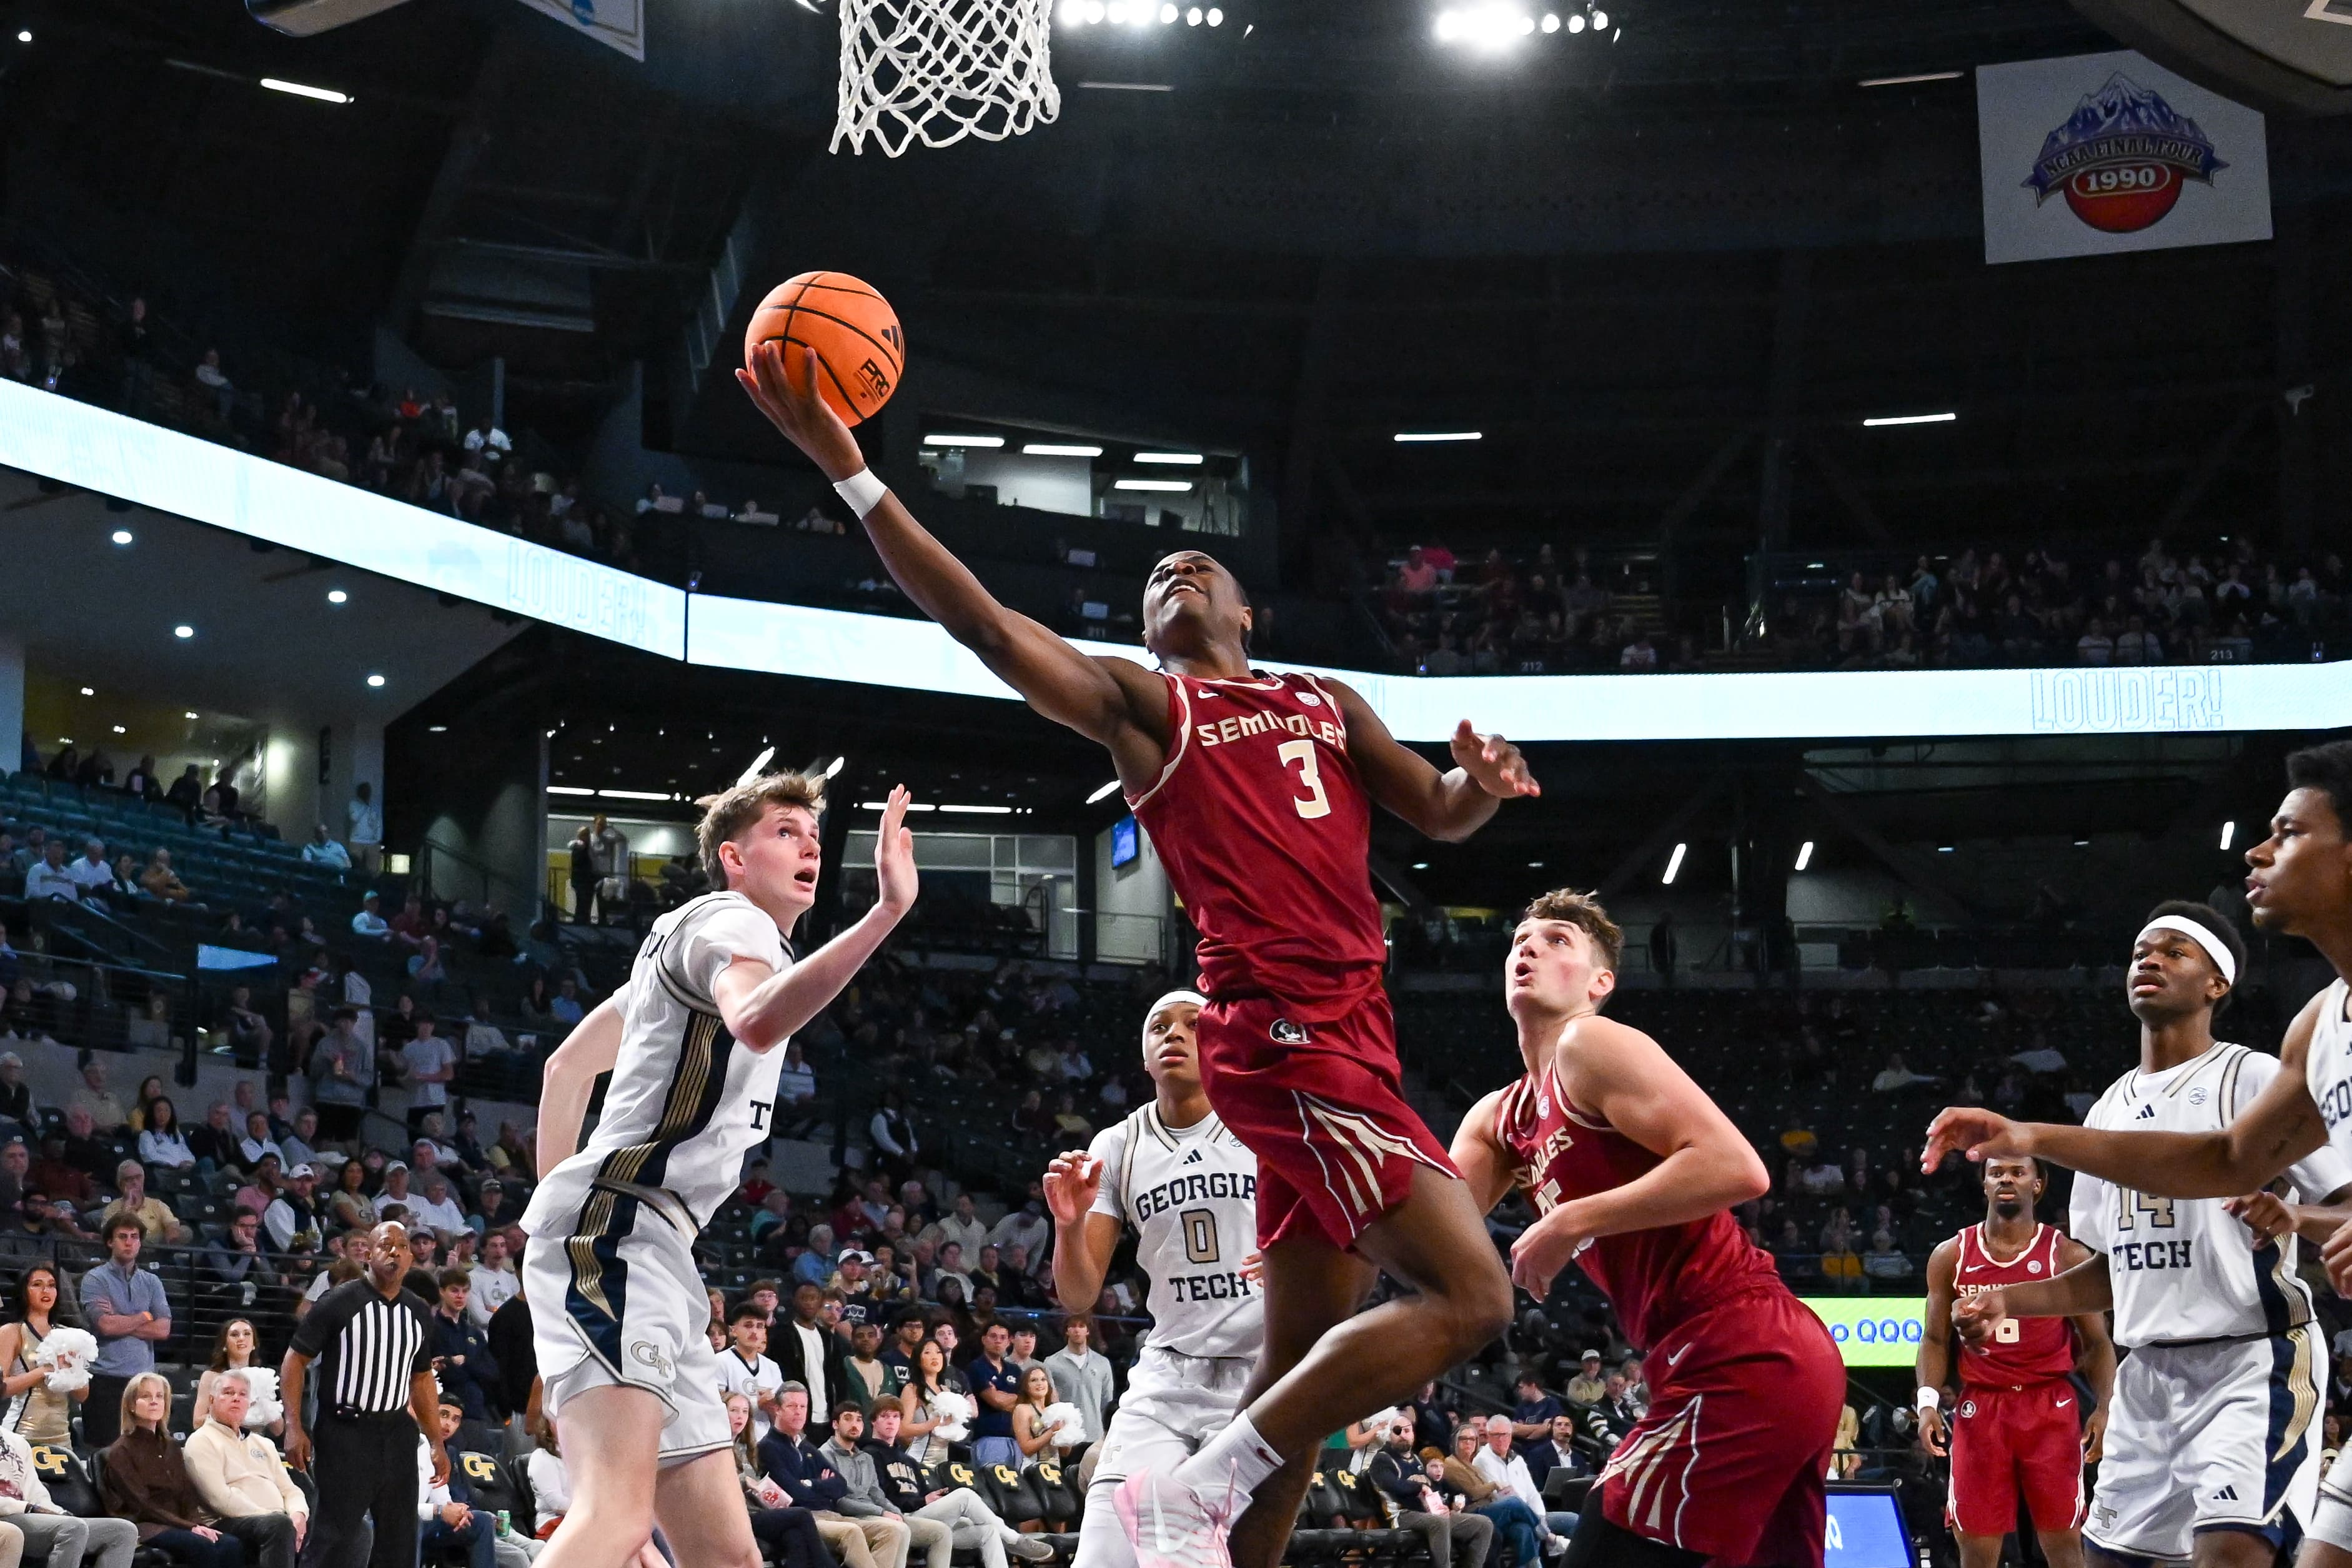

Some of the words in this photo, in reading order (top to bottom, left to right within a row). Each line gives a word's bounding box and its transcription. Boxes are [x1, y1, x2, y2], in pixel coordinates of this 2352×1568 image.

[2042, 144, 2090, 176] NCAA
[2094, 137, 2153, 157] FINAL
[2156, 137, 2203, 162] FOUR
[2087, 167, 2156, 191] 1990
[507, 540, 646, 647] LOUDER!
[2030, 668, 2223, 731] LOUDER!
[1277, 739, 1331, 819] 3
[1136, 1173, 1256, 1223] GEORGIA
[1180, 1208, 1219, 1264] 0
[2113, 1239, 2192, 1273] TECH
[1169, 1272, 1251, 1303] TECH
[1857, 1319, 1922, 1343] QQQ
[464, 1455, 495, 1481] GT
